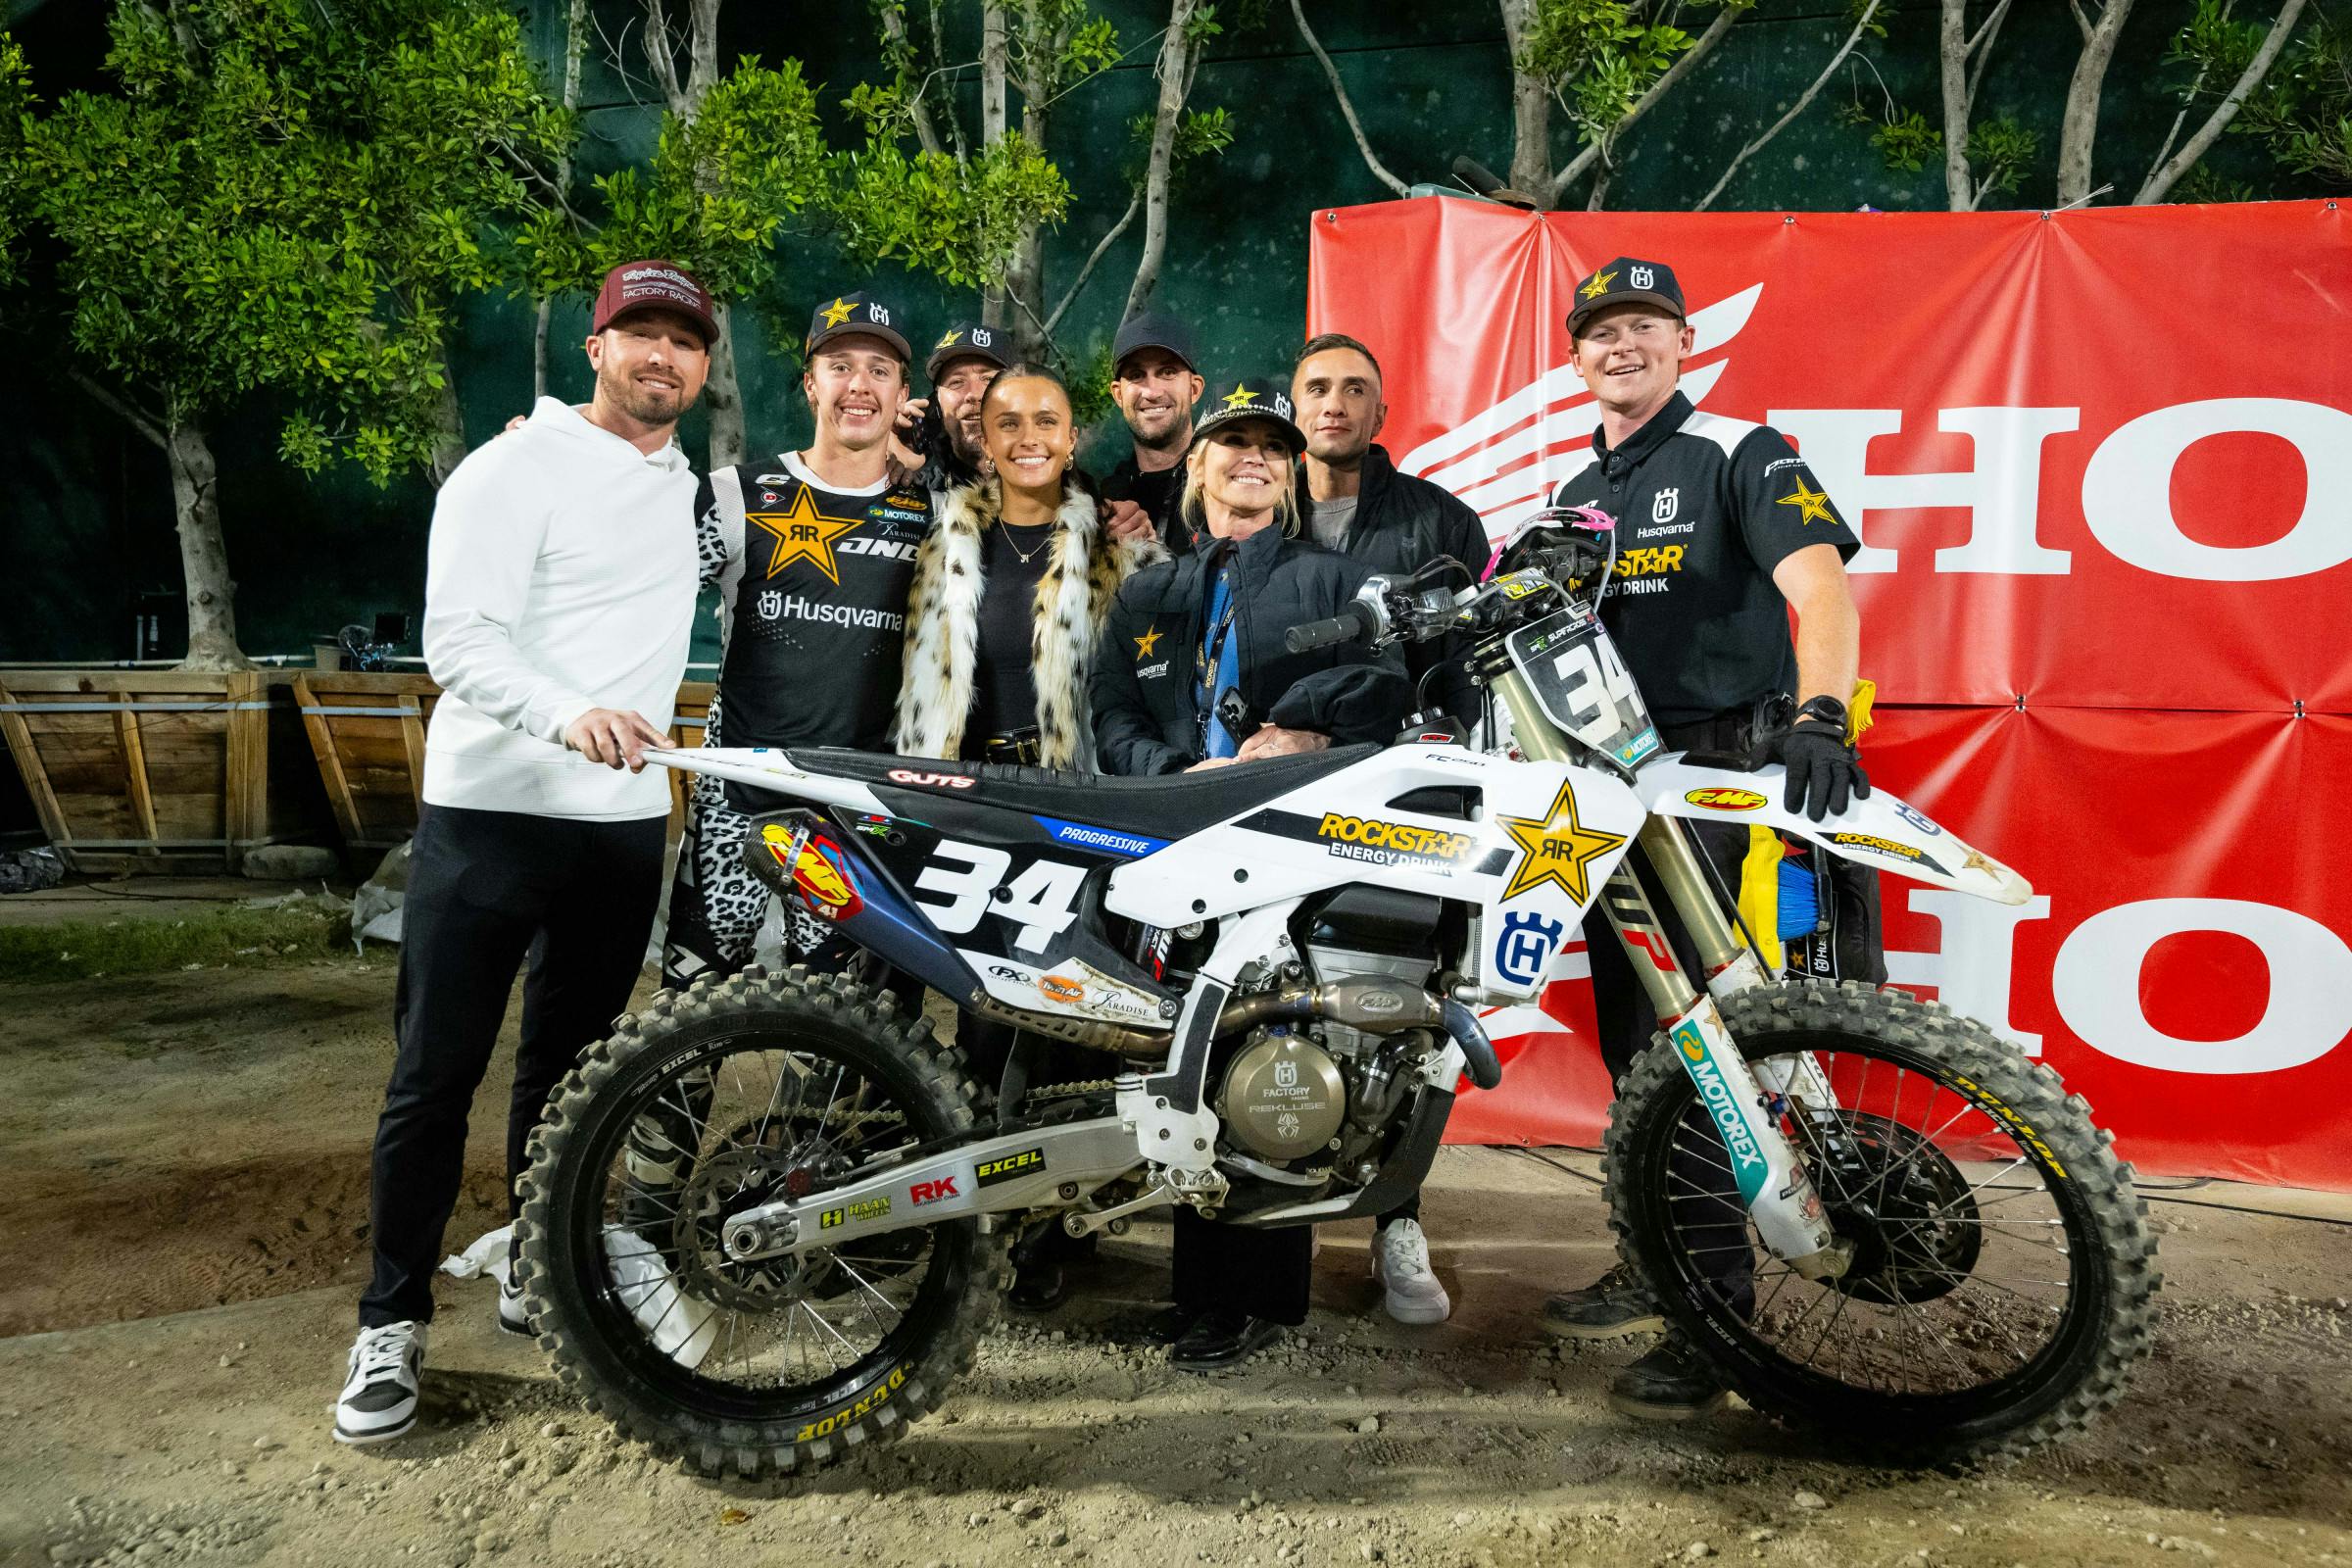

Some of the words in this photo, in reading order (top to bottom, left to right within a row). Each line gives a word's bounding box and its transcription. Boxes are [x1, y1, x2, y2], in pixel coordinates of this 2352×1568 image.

[623, 287, 666, 300] FACTORY
[1766, 397, 2352, 582] HO
[884, 510, 925, 522] MOTOREX
[1637, 521, 1695, 539] Husqvarna
[1623, 578, 1669, 595] DRINK
[783, 595, 904, 632] Husqvarna
[1137, 662, 1167, 678] usqvarna
[1552, 632, 1645, 746] 34
[887, 768, 976, 789] GUTS
[1687, 791, 1766, 806] FMF
[1059, 825, 1151, 855] PROGRESSIVE
[1318, 813, 1472, 860] ROCKSTAR
[1834, 832, 1922, 859] ROCKSTAR
[1330, 842, 1397, 865] ENERGY
[1398, 856, 1452, 875] DRINK
[1843, 842, 1882, 855] ENERGY
[1882, 850, 1913, 863] DRINK
[913, 839, 1088, 955] 34
[1095, 988, 1150, 1016] PARADISE
[661, 1048, 703, 1074] EXCEL
[1263, 1086, 1310, 1098] FACTORY
[1249, 1102, 1326, 1113] REKLUSE
[1692, 1060, 1763, 1169] MOTOREX
[1954, 1076, 2069, 1178] DUNLOP
[978, 1150, 1043, 1177] EXCEL
[909, 1176, 957, 1205] RK
[849, 1197, 892, 1216] HAAN
[796, 1367, 906, 1443] DUNLOP
